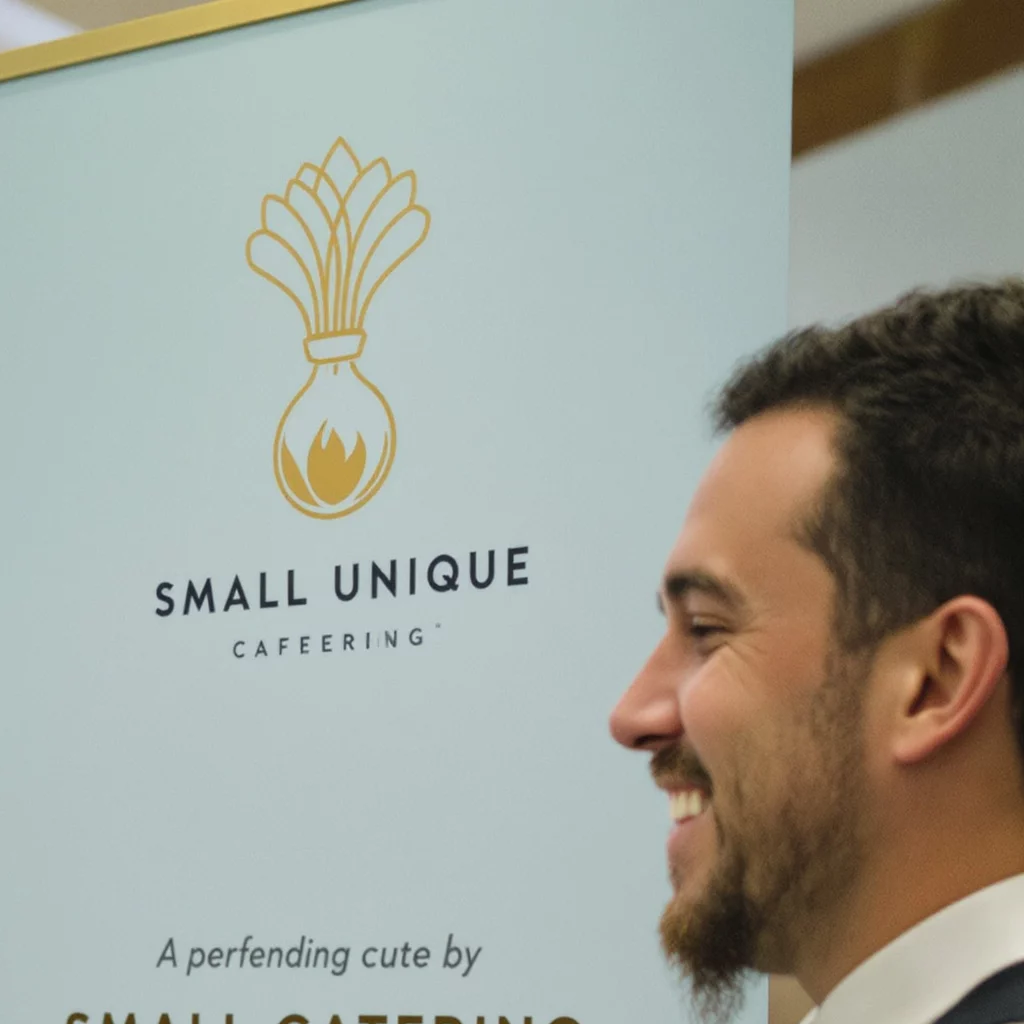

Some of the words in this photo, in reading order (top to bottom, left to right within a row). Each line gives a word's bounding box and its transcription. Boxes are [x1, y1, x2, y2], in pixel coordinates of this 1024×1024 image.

[154, 568, 308, 618] SMALL
[333, 545, 531, 603] UNIQUE
[155, 936, 178, 969] A
[185, 934, 351, 977] perfending
[361, 939, 432, 969] cute
[441, 932, 483, 978] by
